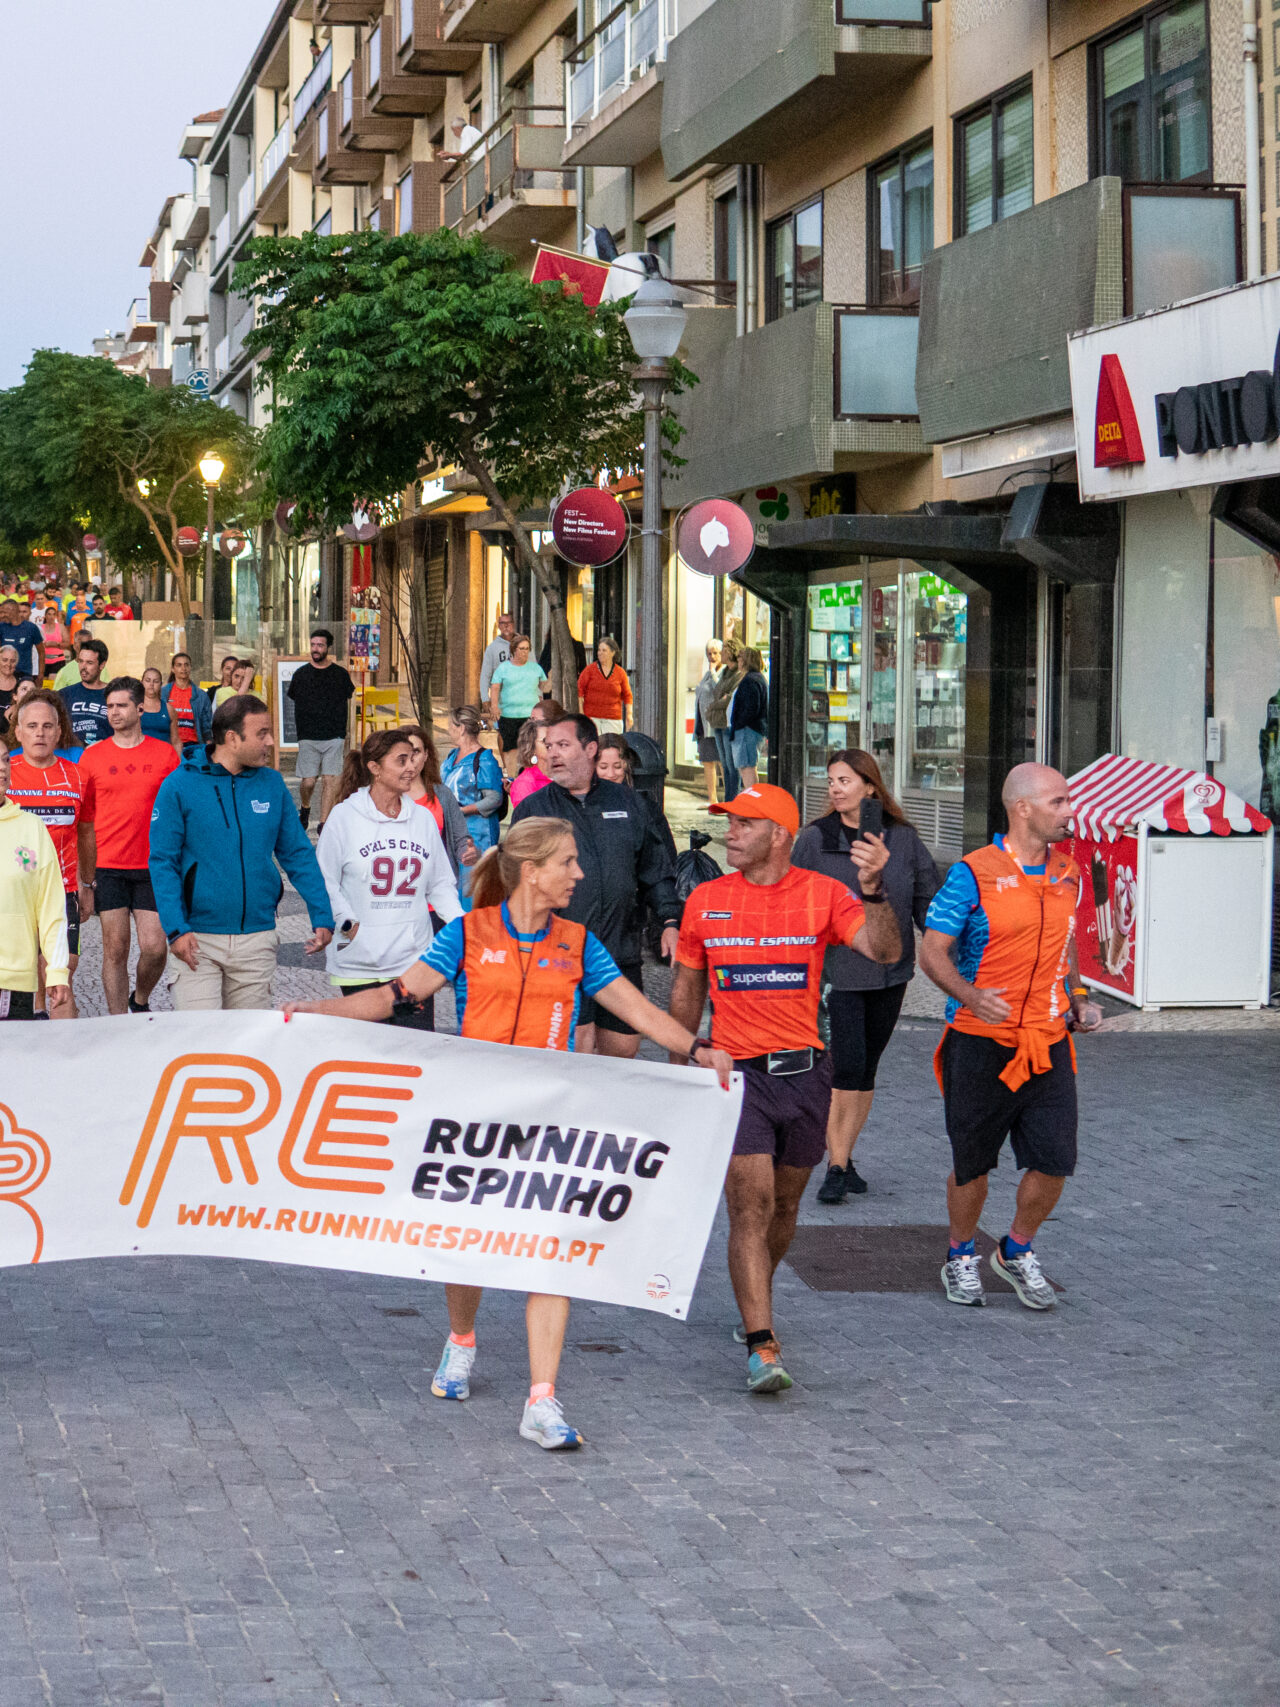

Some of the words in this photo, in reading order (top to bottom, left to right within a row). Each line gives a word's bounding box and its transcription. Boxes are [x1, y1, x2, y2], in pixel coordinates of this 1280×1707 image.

[1098, 421, 1122, 443] DELTA
[563, 518, 577, 526] New
[578, 518, 604, 528] Directors
[563, 526, 577, 534] New
[577, 527, 593, 535] Films
[593, 528, 616, 537] Festival
[5, 788, 44, 797] RUNNING
[45, 789, 81, 799] ESPINHO
[359, 838, 397, 858] GIRL'S
[399, 839, 430, 860] CREW
[369, 855, 423, 898] 92
[703, 937, 756, 949] RUNNING
[758, 935, 818, 947] ESPINHO
[479, 947, 508, 966] RE
[732, 969, 806, 987] superdecor
[120, 1052, 423, 1229] RE
[422, 1117, 671, 1180] RUNNING
[411, 1160, 634, 1223] ESPINHO
[176, 1202, 606, 1268] WWW.RUNNINGESPINHO.PT
